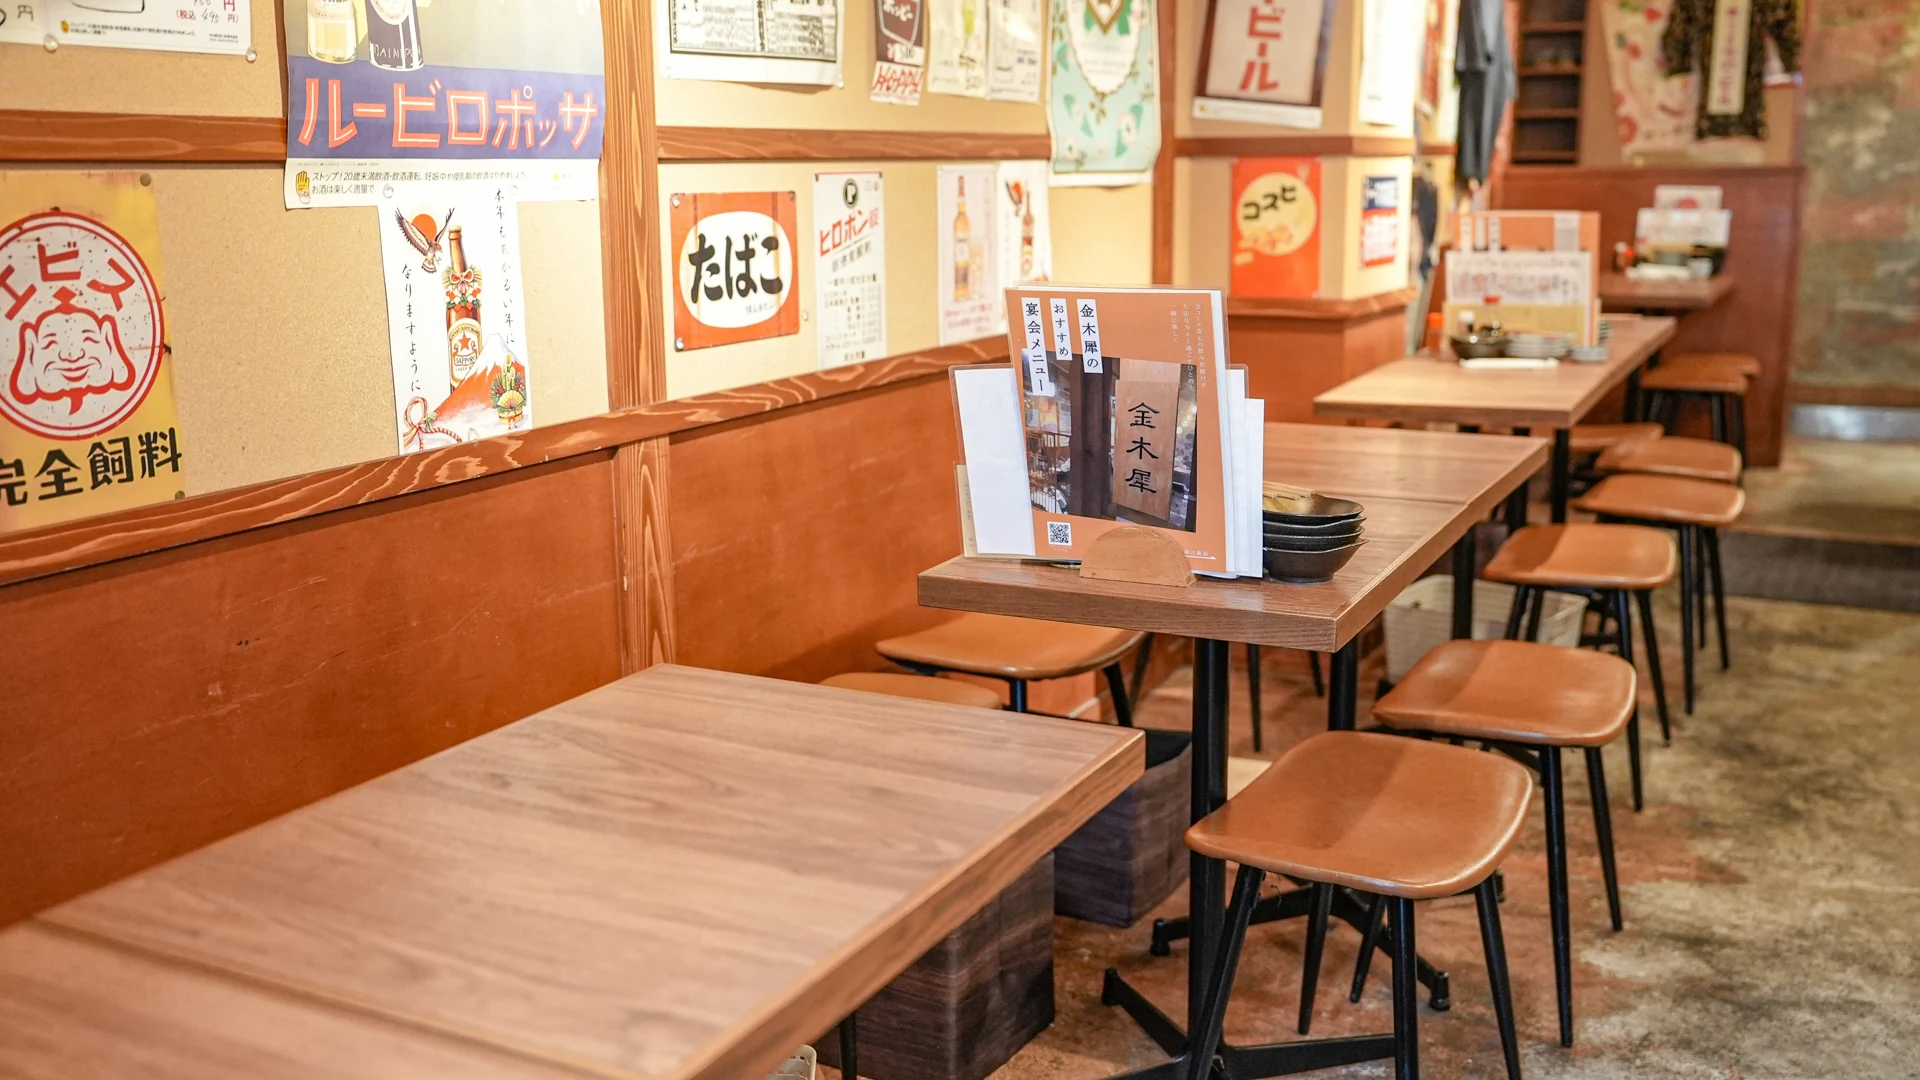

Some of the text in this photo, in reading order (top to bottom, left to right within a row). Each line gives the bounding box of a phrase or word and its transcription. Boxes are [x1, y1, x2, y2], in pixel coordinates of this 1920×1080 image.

[1239, 0, 1285, 92] ビール
[688, 233, 783, 304] たばこ
[402, 264, 421, 392] なりますように
[1025, 302, 1046, 391] 宴会メニュー
[1054, 304, 1069, 356] おすすめ
[1080, 303, 1099, 368] 金木犀の
[1125, 402, 1160, 494] 金木犀
